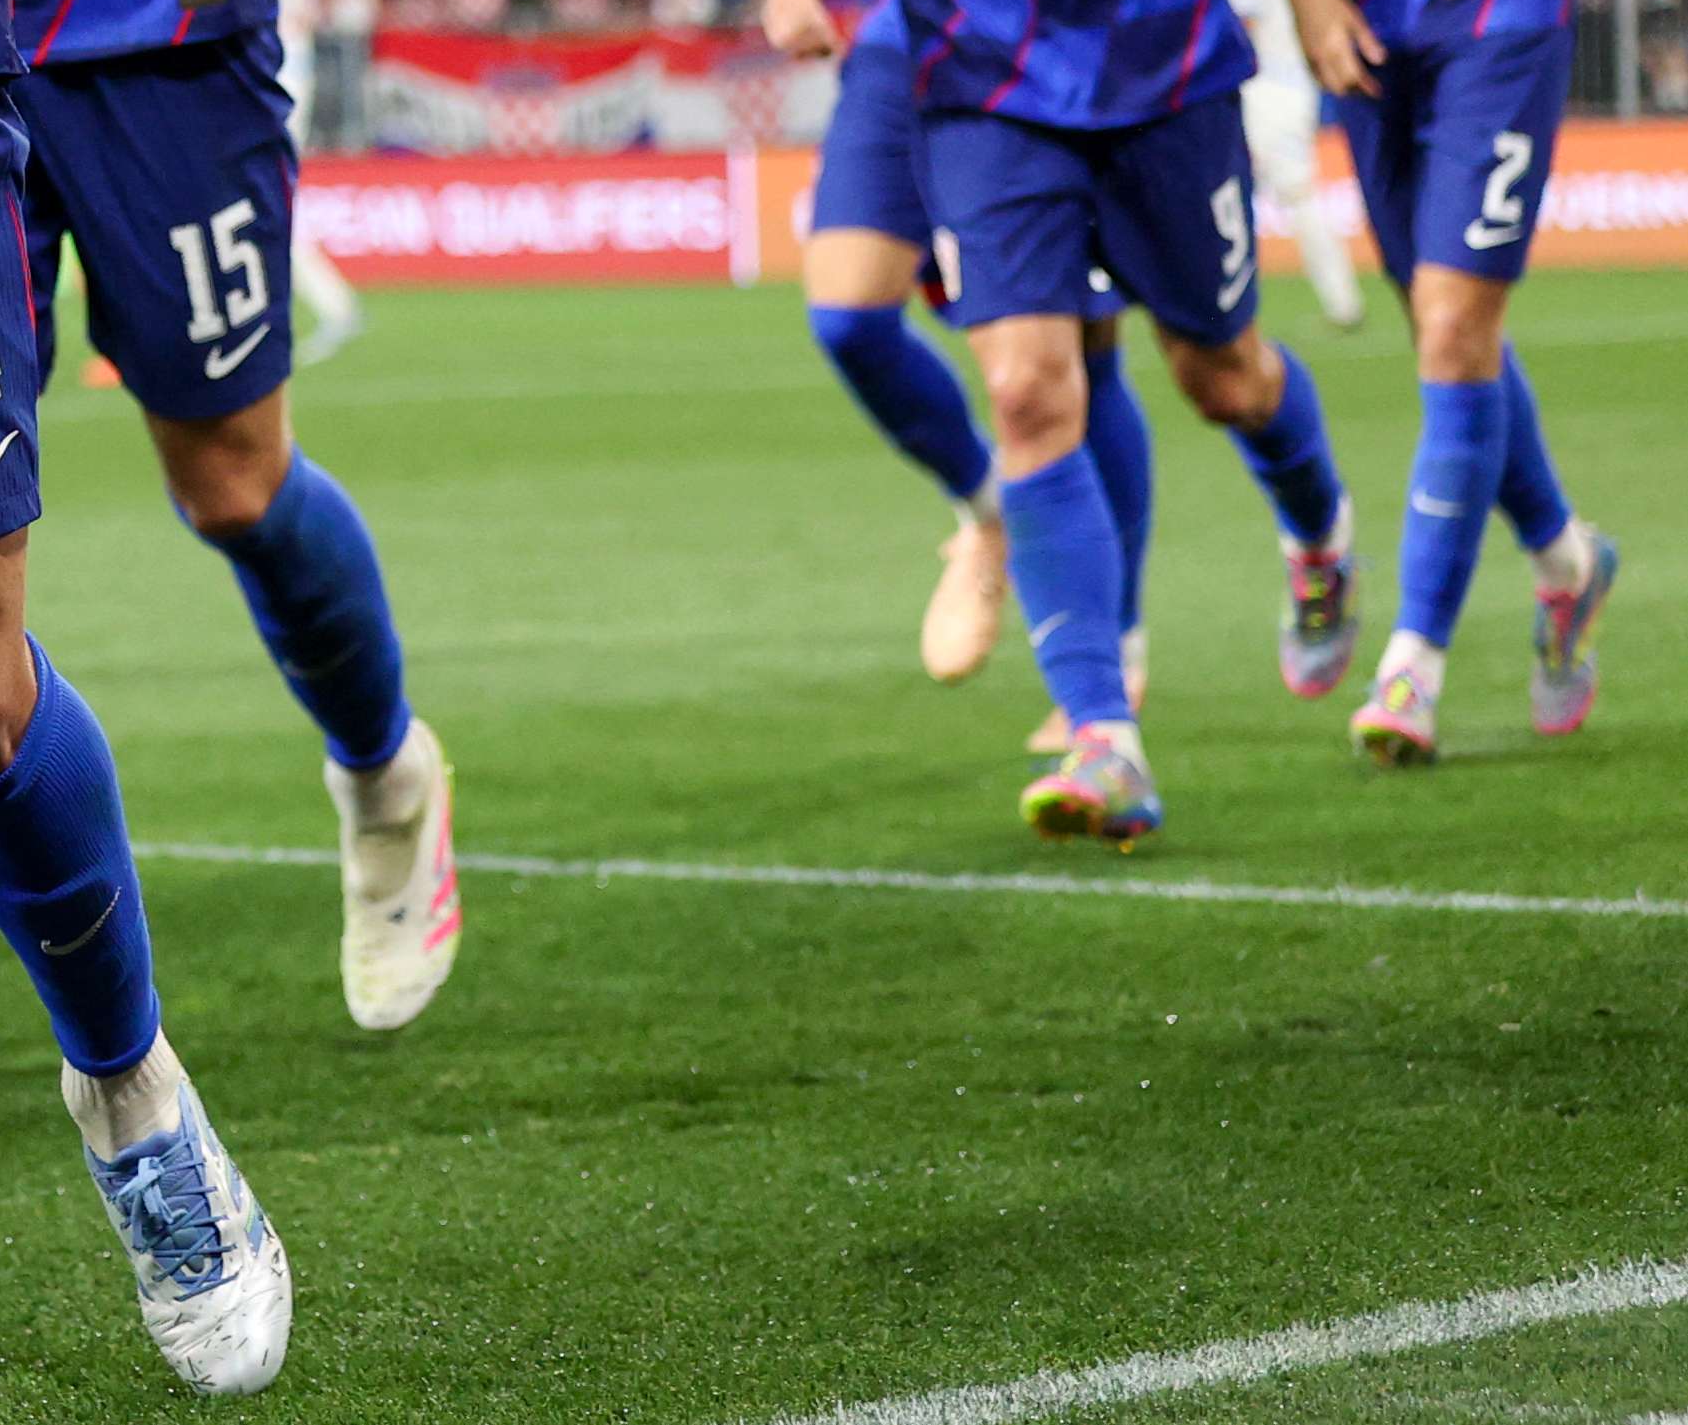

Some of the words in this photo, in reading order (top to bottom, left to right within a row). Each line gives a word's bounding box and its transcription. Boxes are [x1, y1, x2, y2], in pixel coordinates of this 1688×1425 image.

[1210, 177, 1251, 276] 9
[1483, 131, 1534, 227] 2
[169, 198, 269, 343] 15
